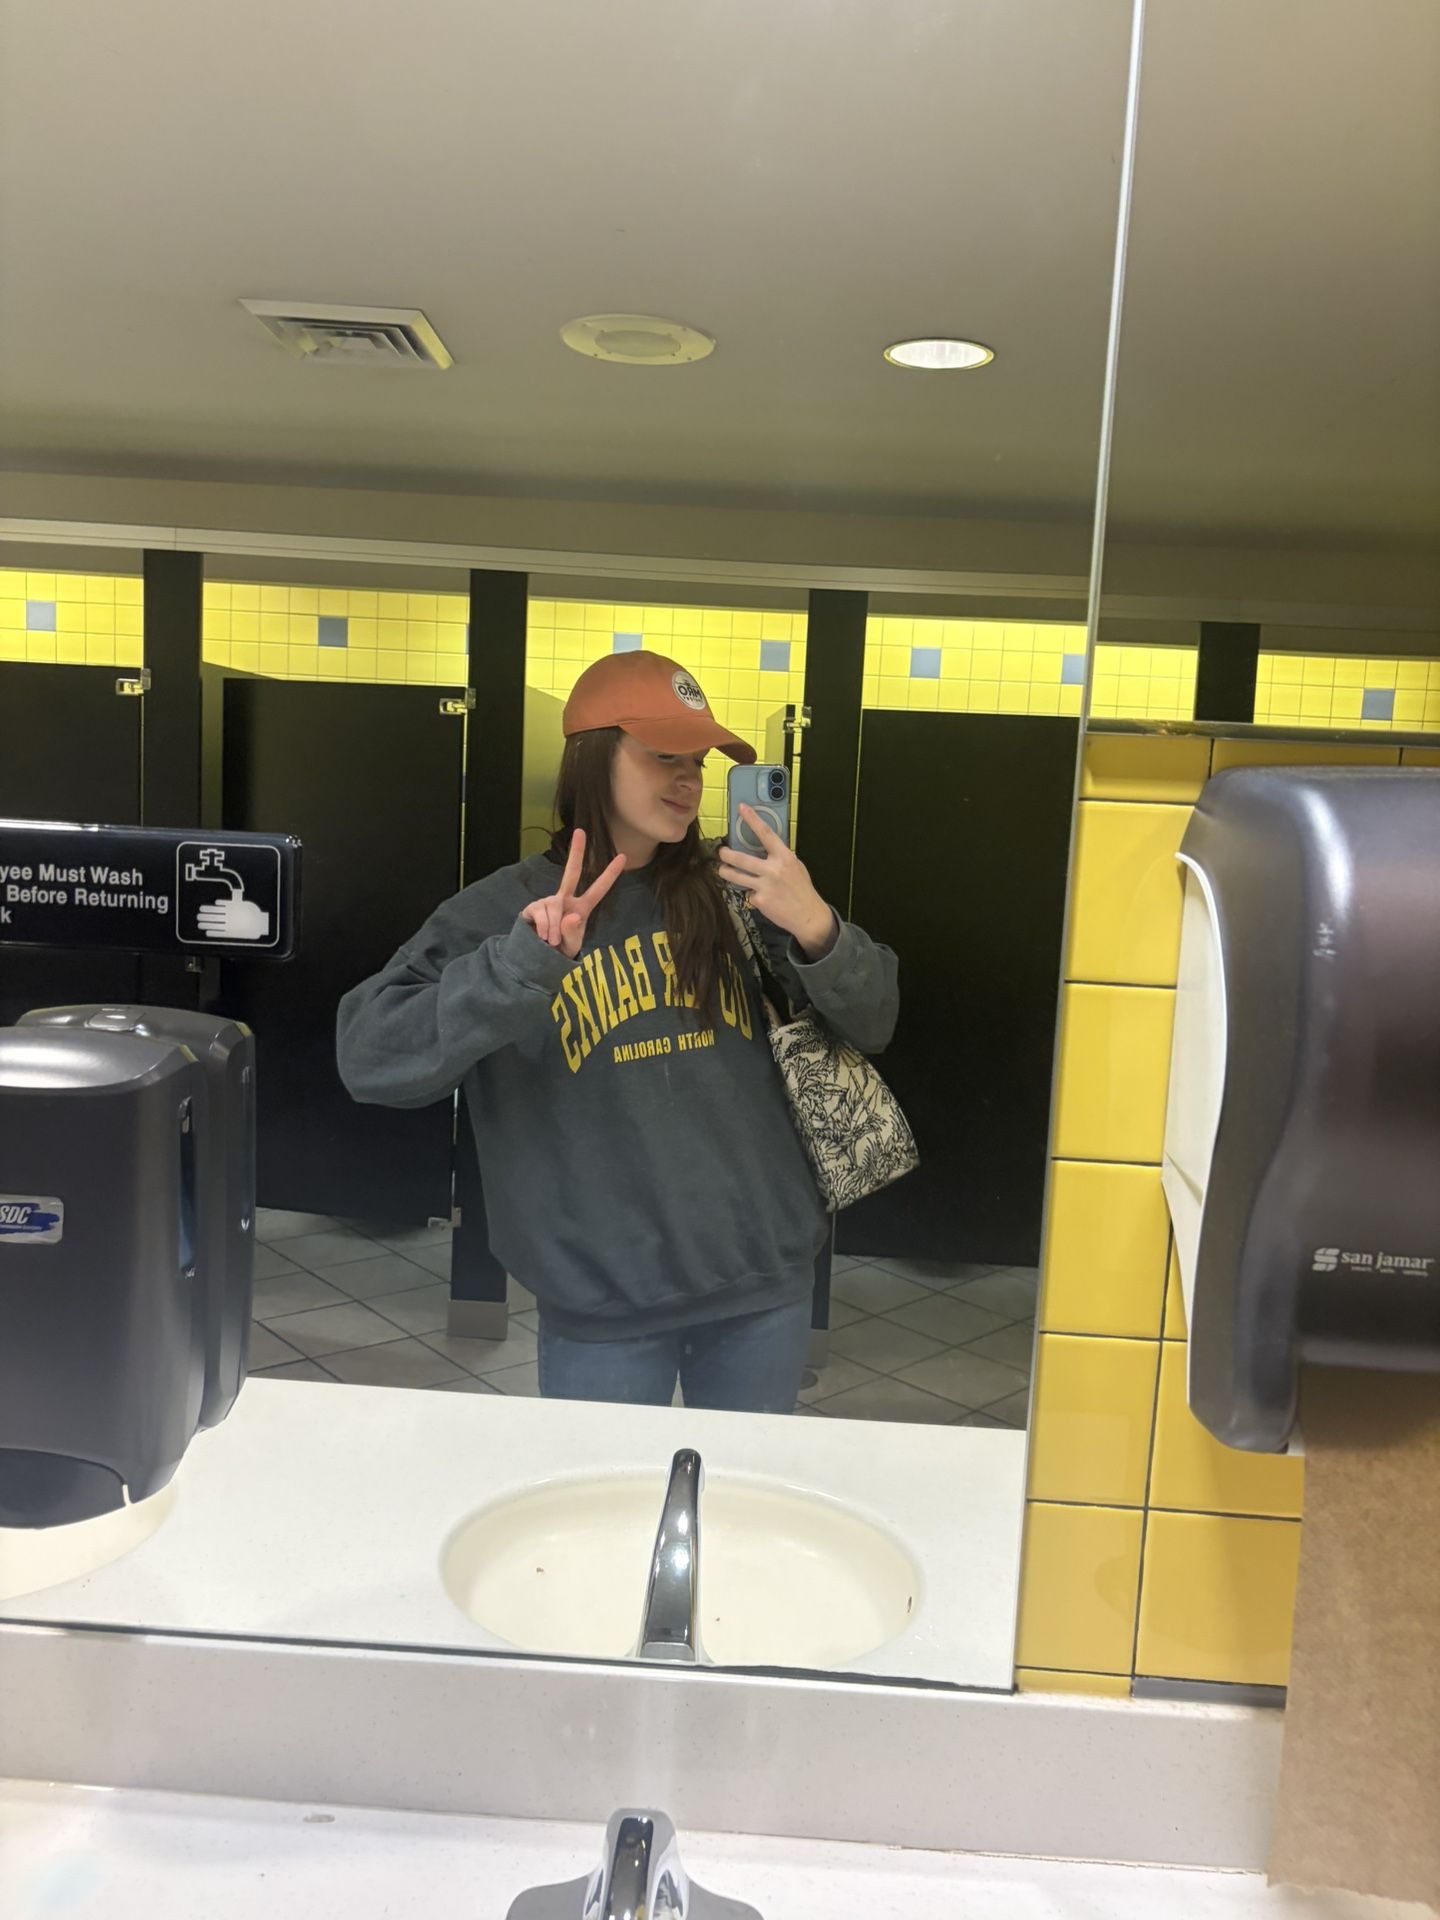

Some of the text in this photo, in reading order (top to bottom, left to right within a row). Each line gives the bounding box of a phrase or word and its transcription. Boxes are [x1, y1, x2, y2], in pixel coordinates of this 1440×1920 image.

[39, 863, 86, 883] Must
[90, 866, 144, 886] Wash
[6, 885, 169, 914] Before Returning
[1341, 1251, 1435, 1270] san jamar
